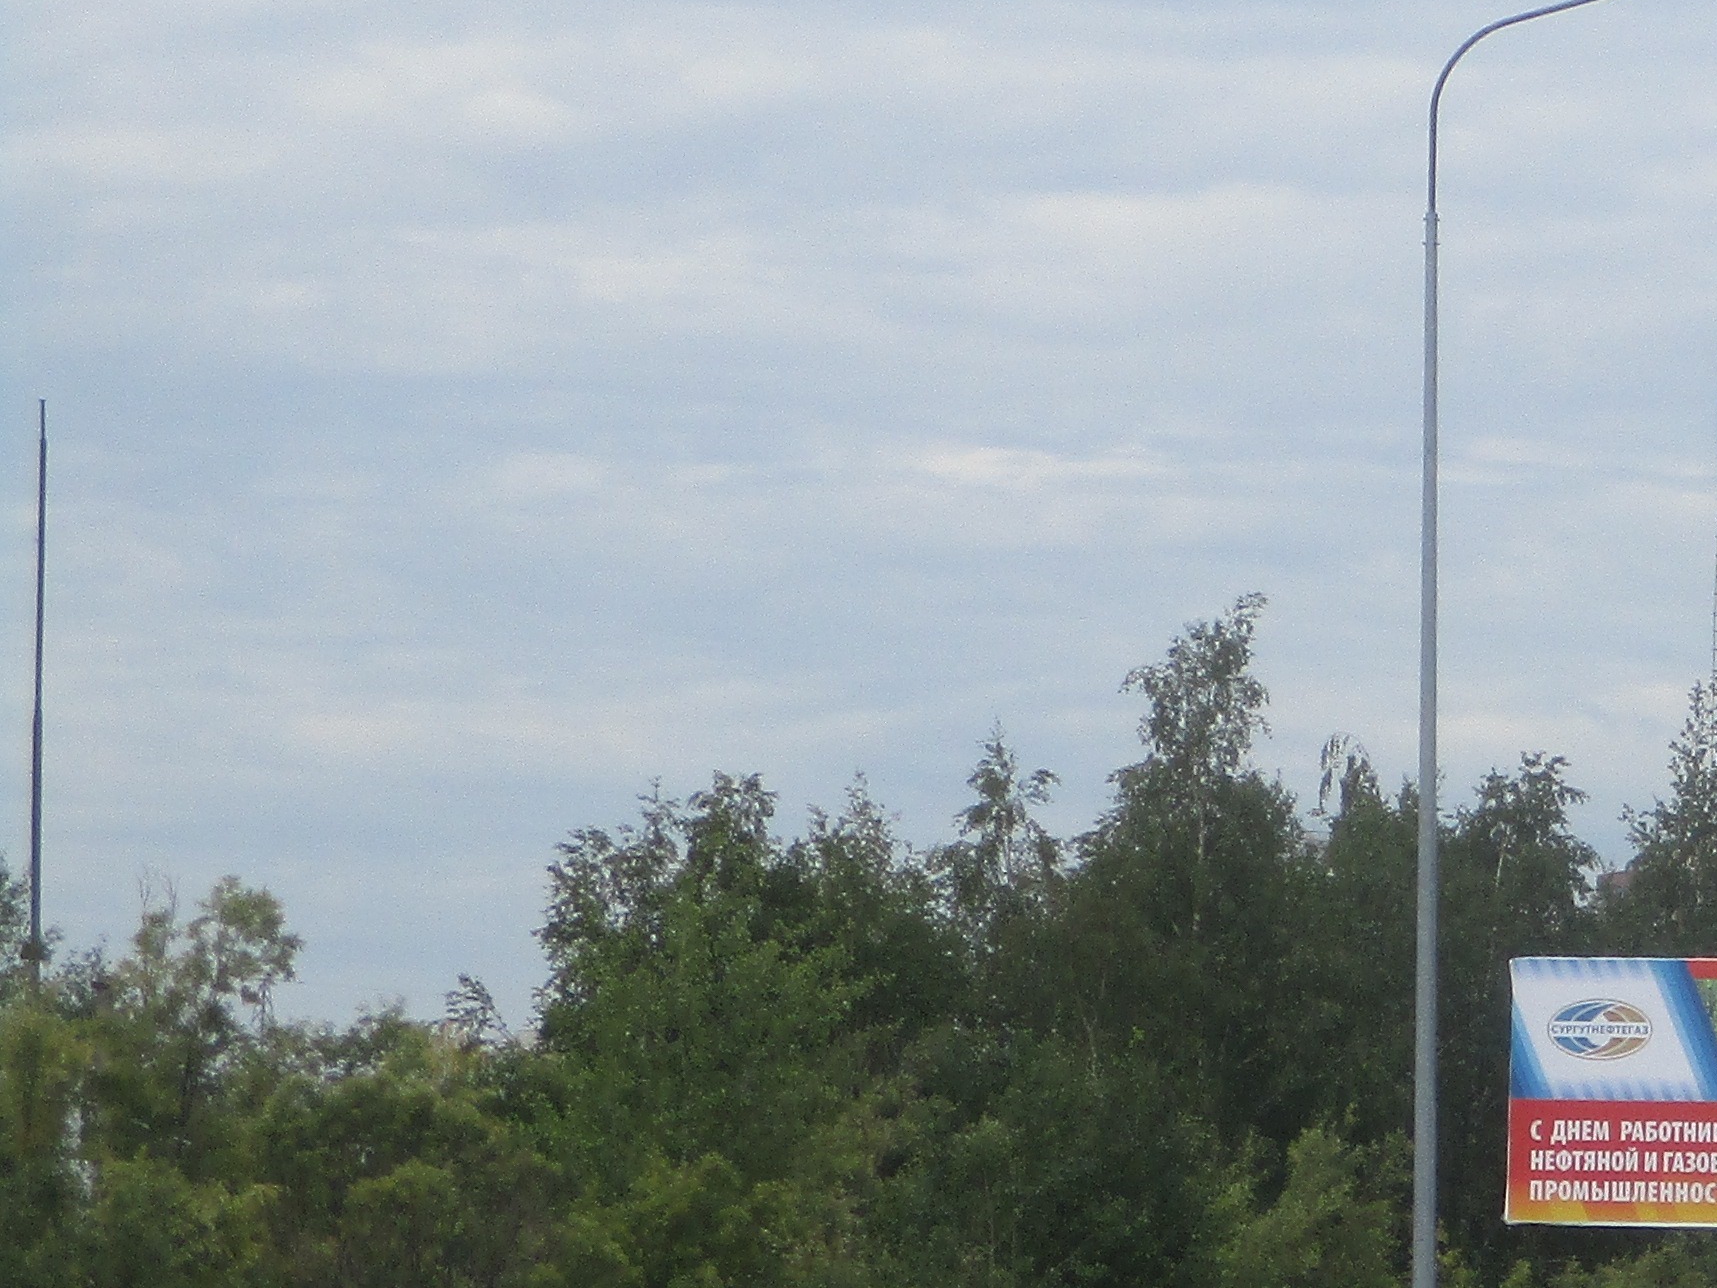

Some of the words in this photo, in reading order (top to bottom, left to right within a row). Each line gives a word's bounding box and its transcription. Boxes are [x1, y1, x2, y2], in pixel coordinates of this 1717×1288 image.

[1551, 1025, 1649, 1035] СУРГУТНЕФТЕГАЗ
[1530, 1120, 1542, 1142] С
[1550, 1119, 1610, 1145] ДНЕМ
[1530, 1147, 1639, 1172] НЕФТЯНОЙ
[1644, 1152, 1659, 1172] И
